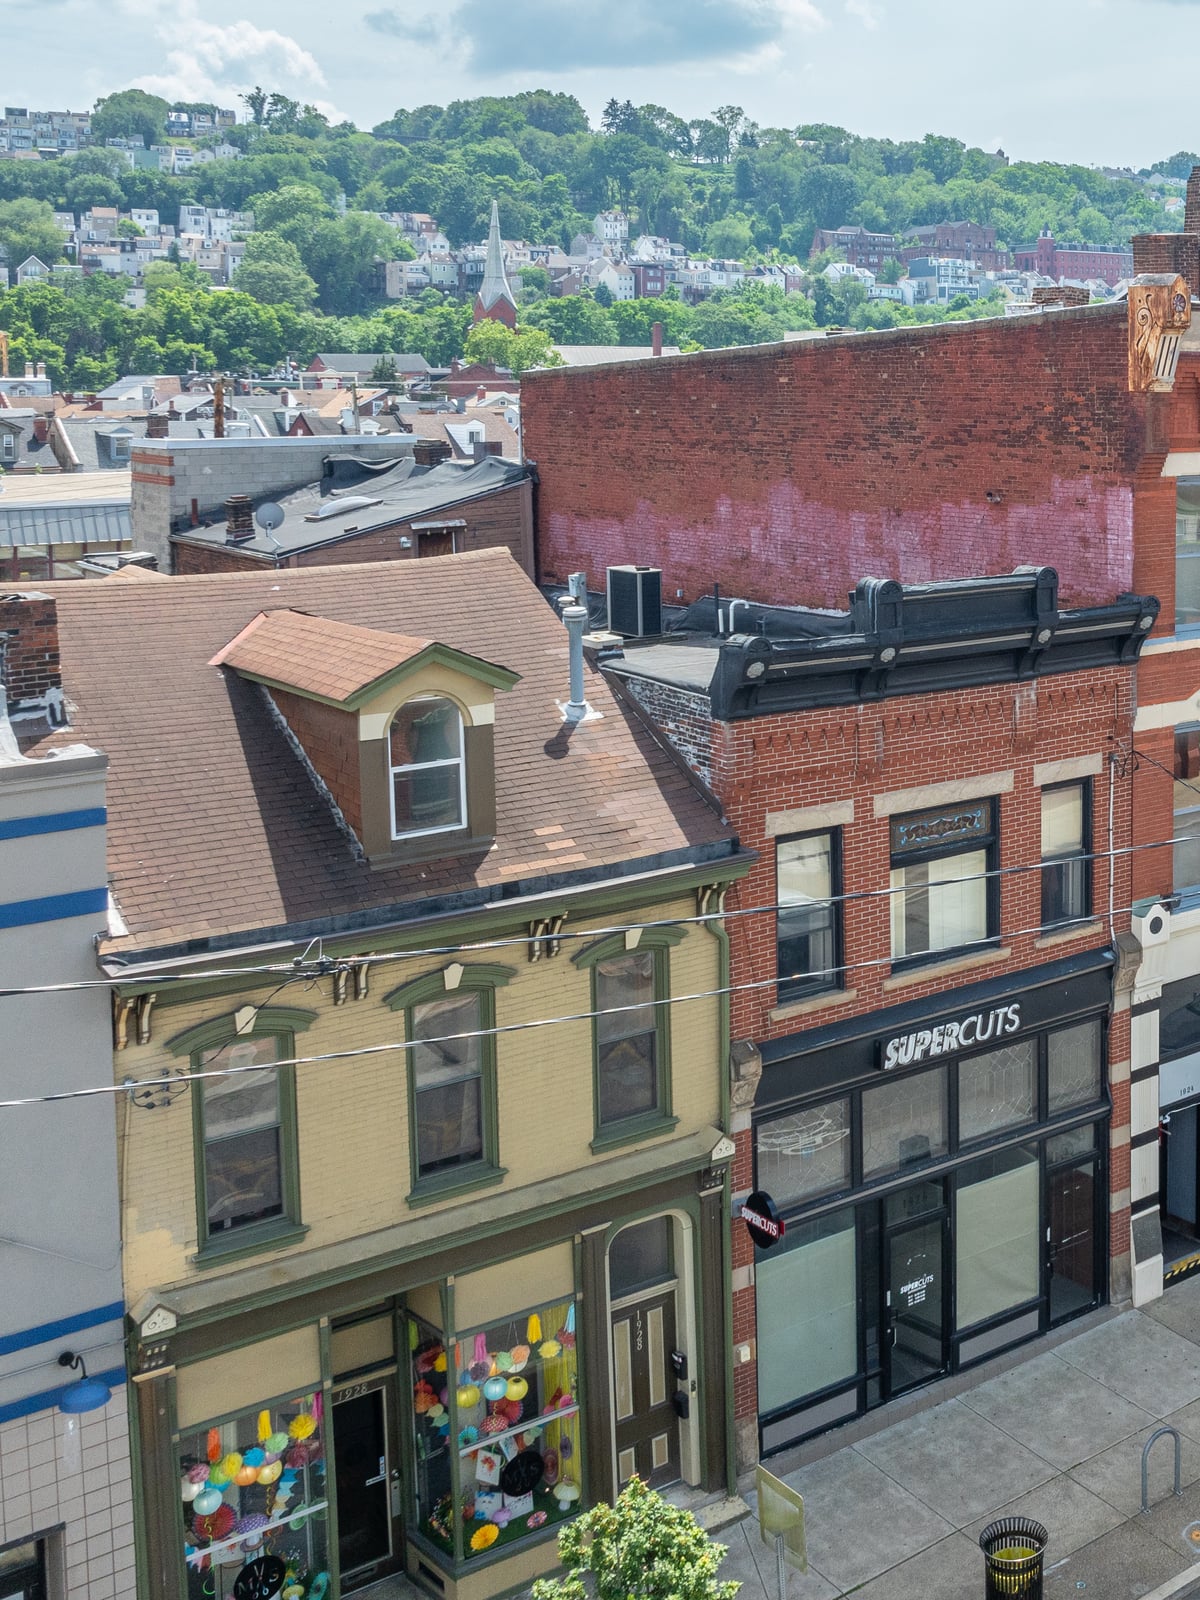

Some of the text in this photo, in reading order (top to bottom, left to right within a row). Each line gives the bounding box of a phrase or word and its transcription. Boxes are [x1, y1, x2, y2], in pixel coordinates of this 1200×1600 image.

[884, 1003, 1021, 1071] SUPERCUTS
[741, 1206, 778, 1237] SUPERCUTS
[900, 1274, 934, 1294] SUPERCUTS
[338, 1383, 368, 1401] 1928
